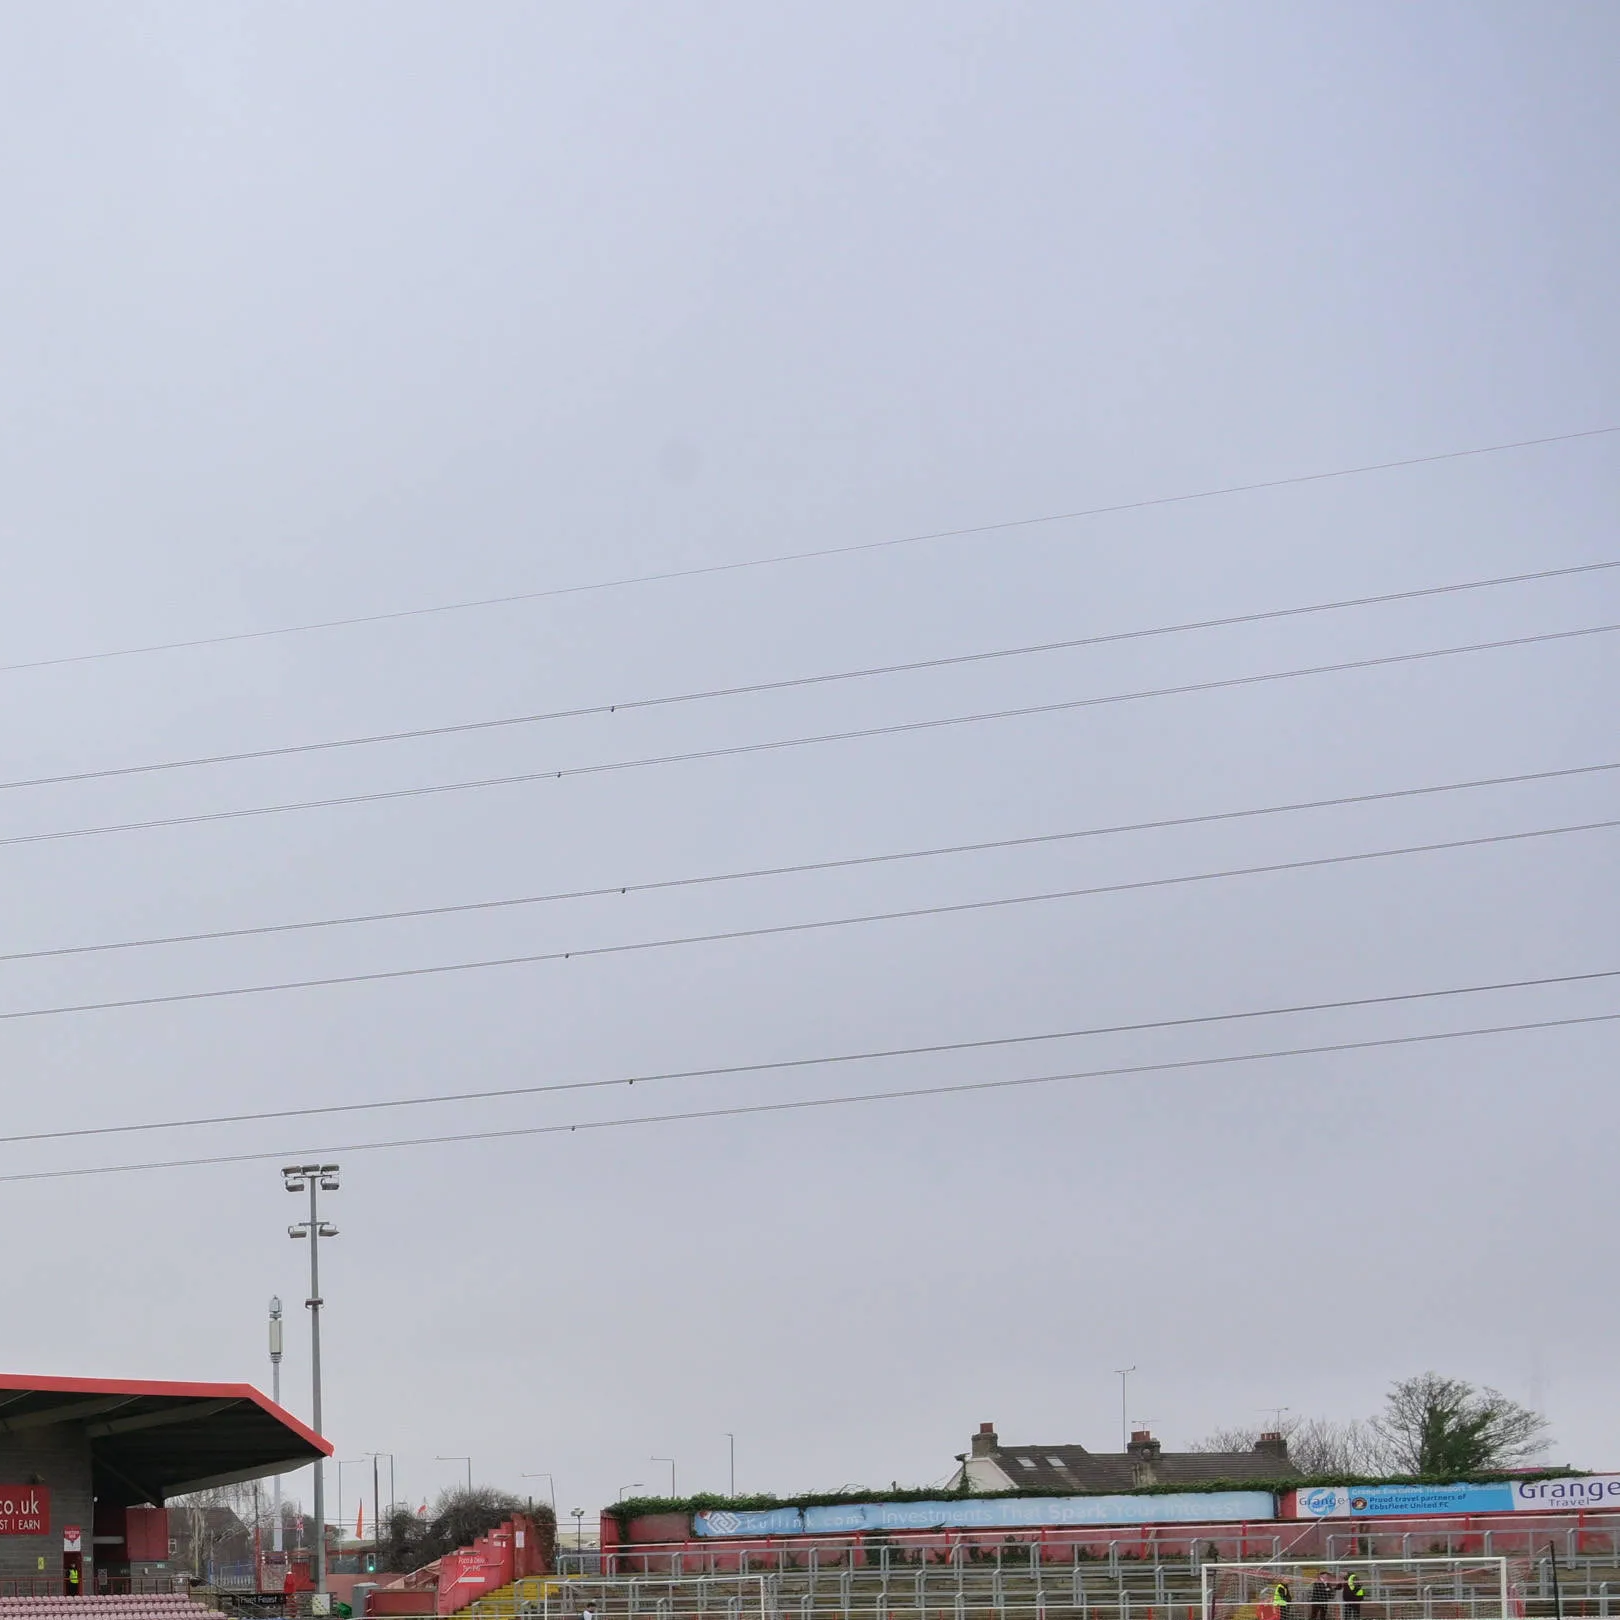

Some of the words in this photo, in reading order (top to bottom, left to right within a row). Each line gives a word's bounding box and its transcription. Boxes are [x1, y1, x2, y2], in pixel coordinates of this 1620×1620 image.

[1518, 1480, 1620, 1501] Grange
[1394, 1495, 1419, 1503] travel
[1420, 1494, 1456, 1504] partners
[1457, 1493, 1467, 1501] of
[1548, 1496, 1590, 1507] Travel
[1369, 1502, 1409, 1510] Ebbsfleet
[1410, 1501, 1437, 1510] United
[881, 1508, 994, 1525] Investments
[1049, 1505, 1107, 1522] Spark
[18, 1519, 41, 1530] EARN
